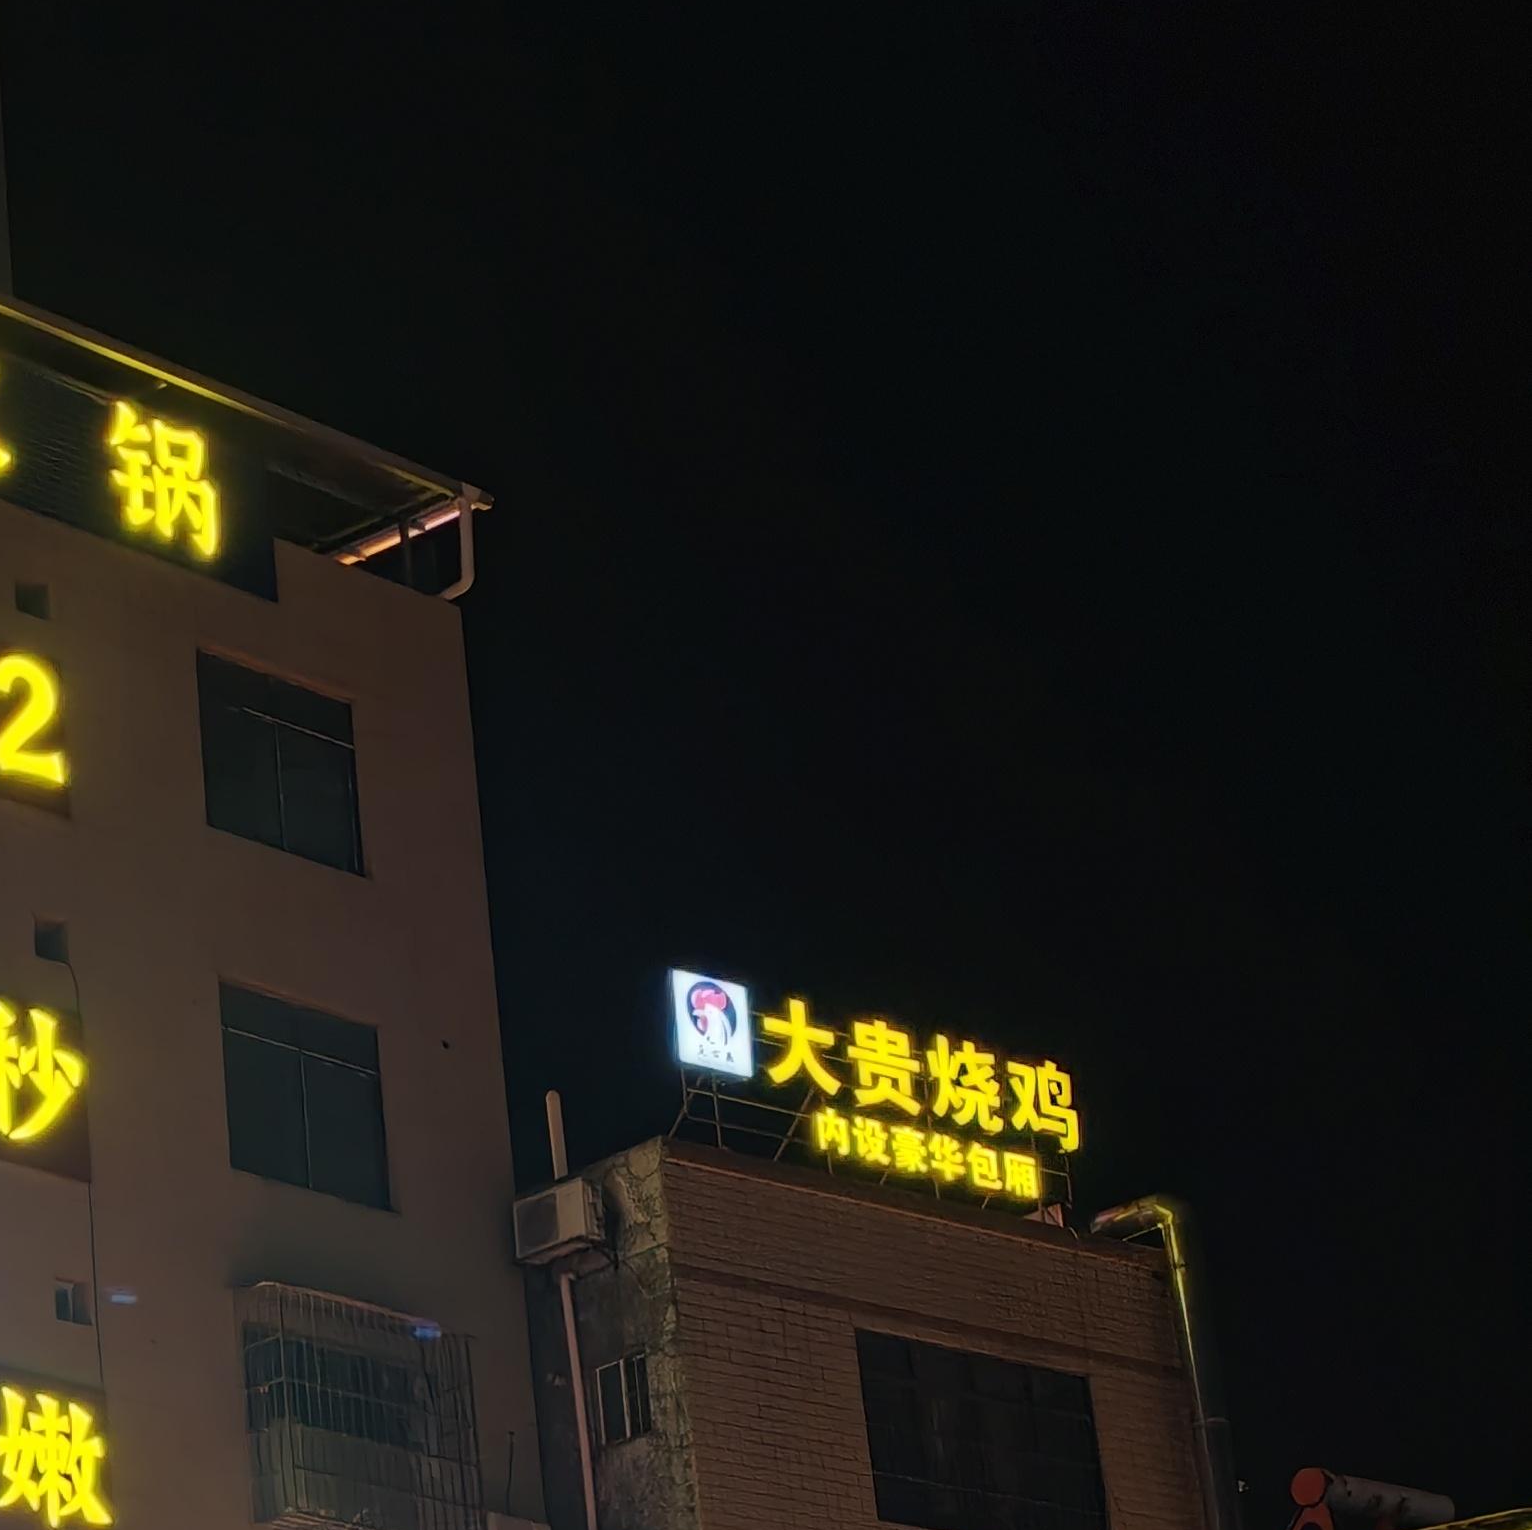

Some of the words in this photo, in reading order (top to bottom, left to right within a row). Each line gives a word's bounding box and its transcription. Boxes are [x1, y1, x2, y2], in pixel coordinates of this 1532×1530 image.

[763, 998, 1080, 1152] 大贵烧鸡
[816, 1106, 1041, 1200] 内设豪华包厢
